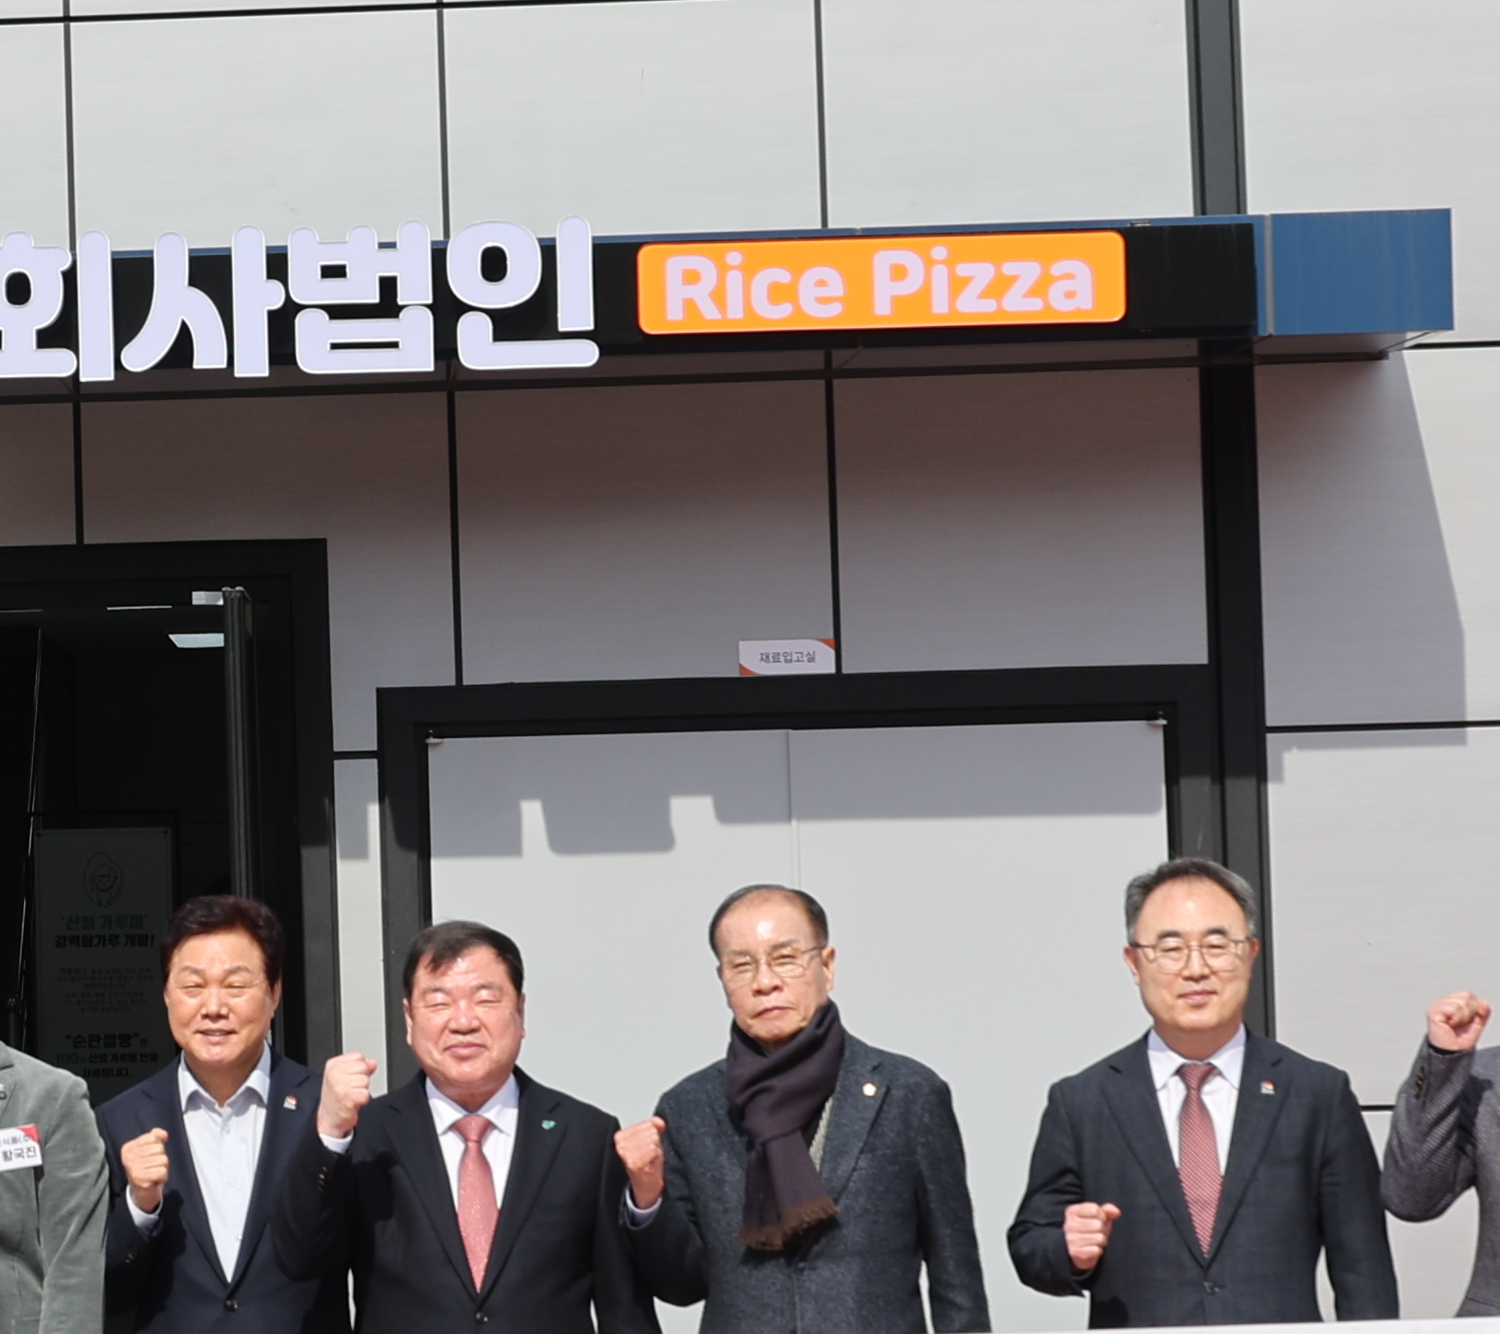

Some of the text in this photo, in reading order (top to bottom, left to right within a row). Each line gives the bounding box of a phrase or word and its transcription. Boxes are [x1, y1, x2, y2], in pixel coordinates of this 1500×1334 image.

[664, 245, 1095, 322] Rice Pizza
[758, 651, 817, 664] 재료입고실
